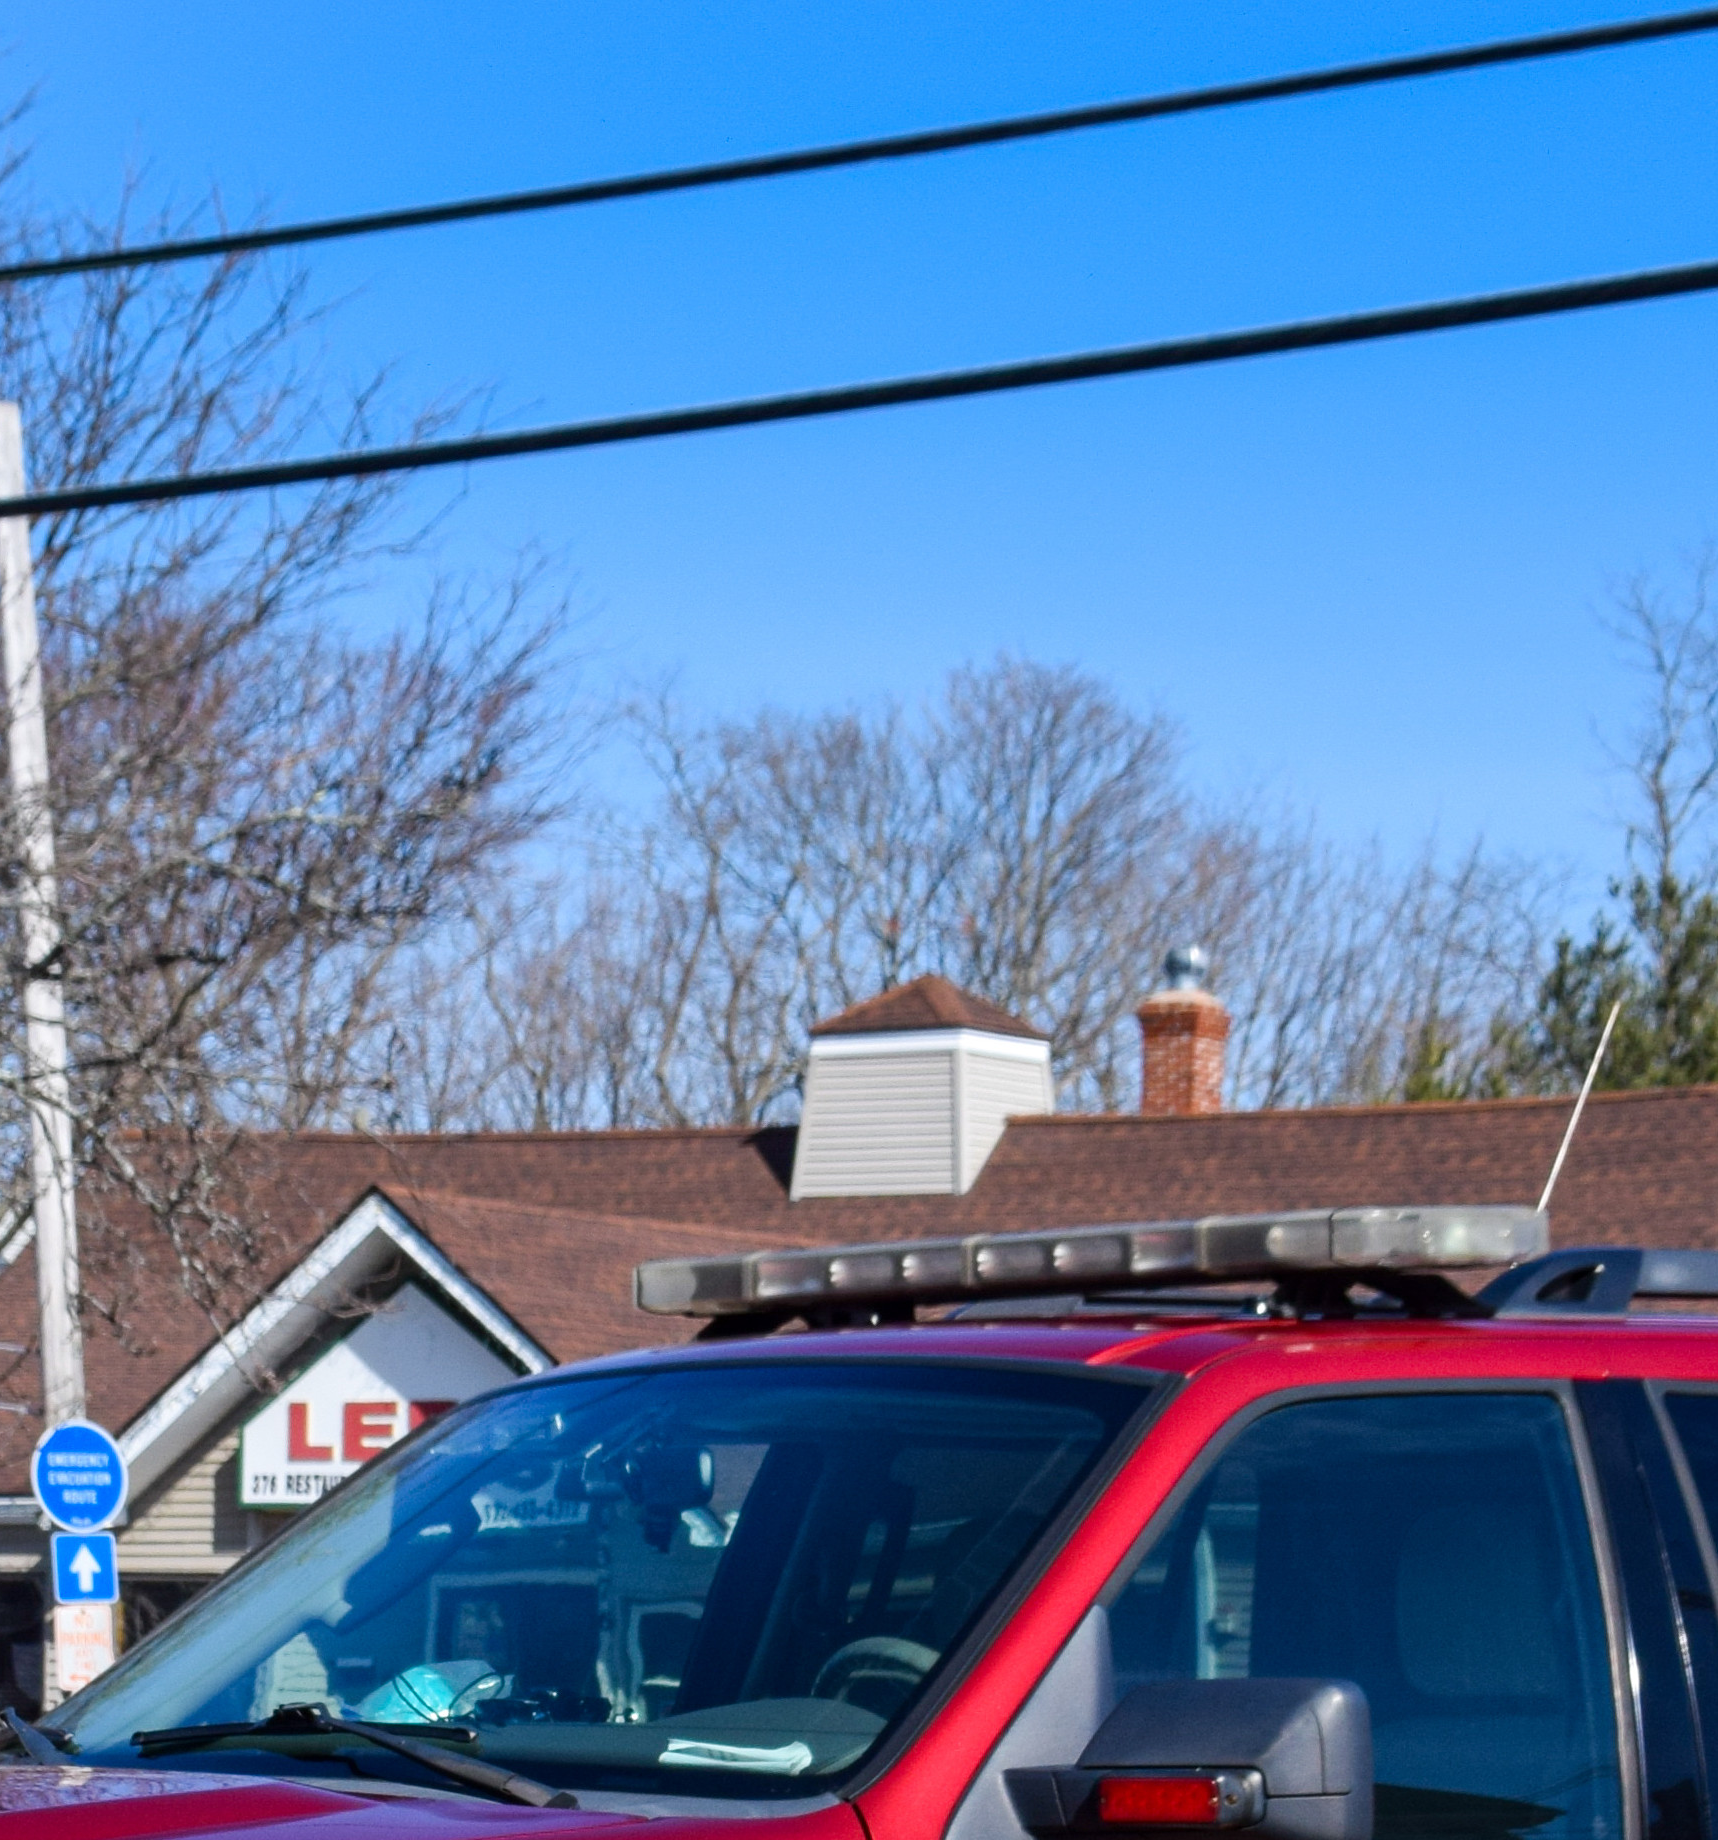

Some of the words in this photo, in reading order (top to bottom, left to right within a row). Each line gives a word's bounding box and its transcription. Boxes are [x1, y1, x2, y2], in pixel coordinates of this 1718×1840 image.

[47, 1452, 109, 1467] EMERGENCY
[48, 1471, 111, 1486] EVACUATION
[63, 1489, 98, 1504] ROUTE
